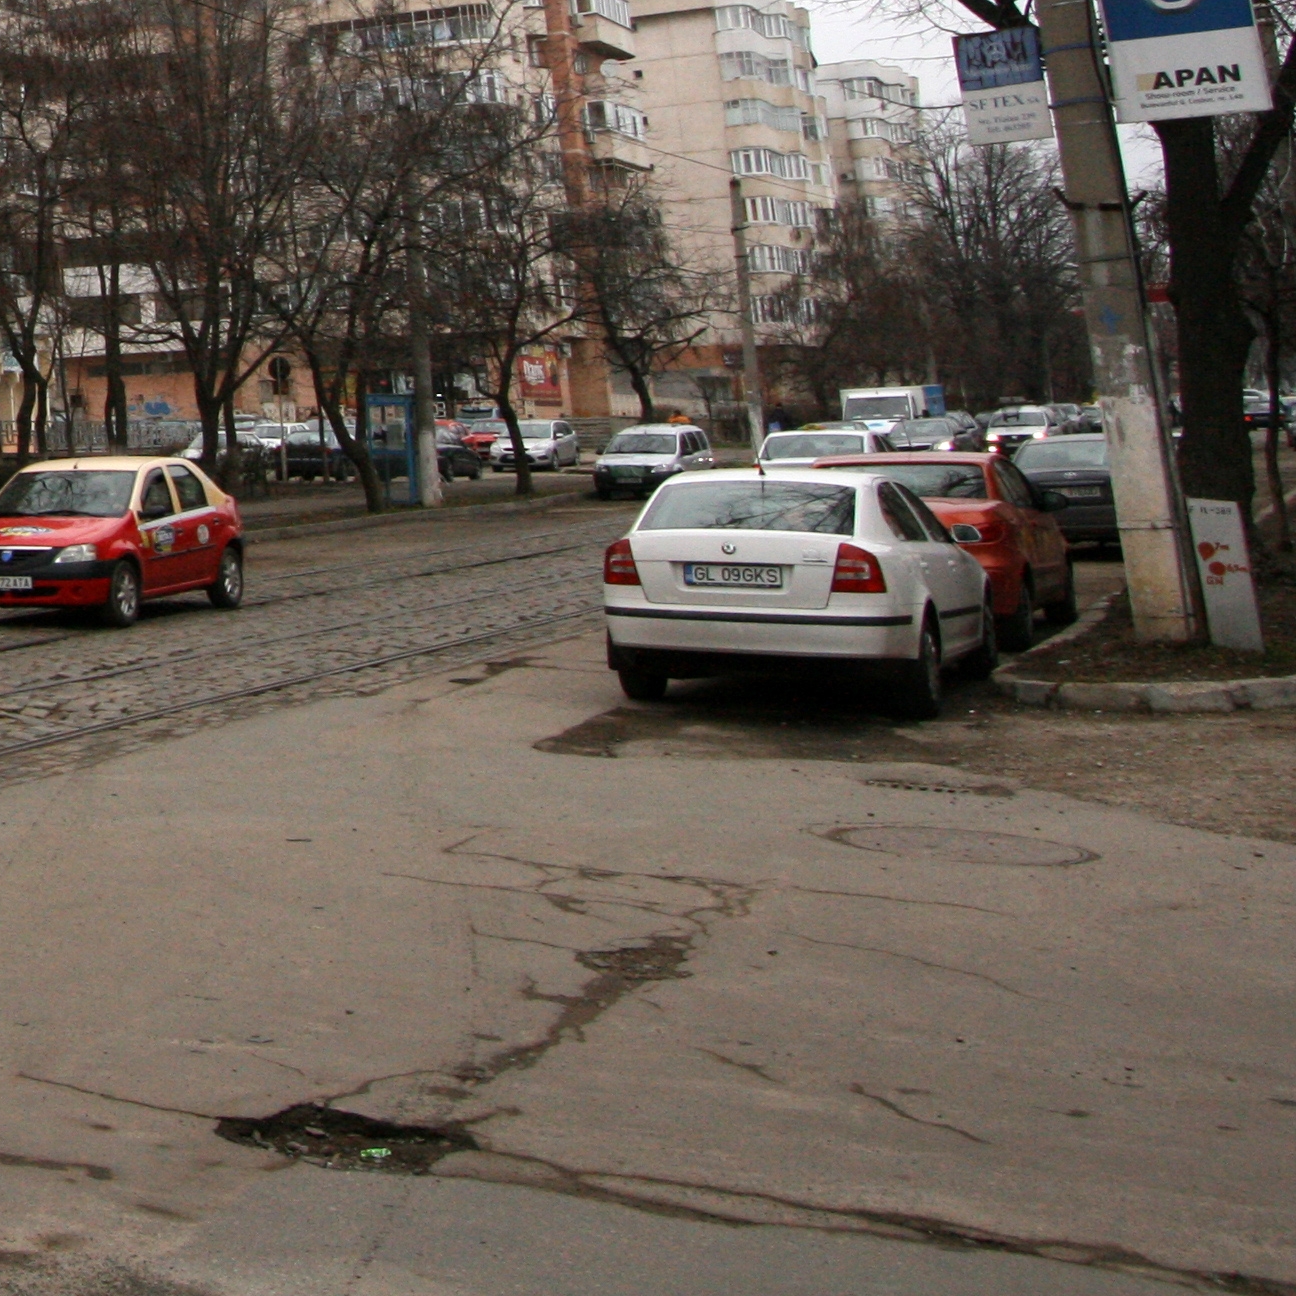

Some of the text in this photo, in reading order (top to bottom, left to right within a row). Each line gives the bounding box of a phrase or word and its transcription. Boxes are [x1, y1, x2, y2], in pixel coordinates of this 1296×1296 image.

[1152, 64, 1241, 90] APAN
[1204, 86, 1235, 95] Service
[694, 567, 715, 582] GL
